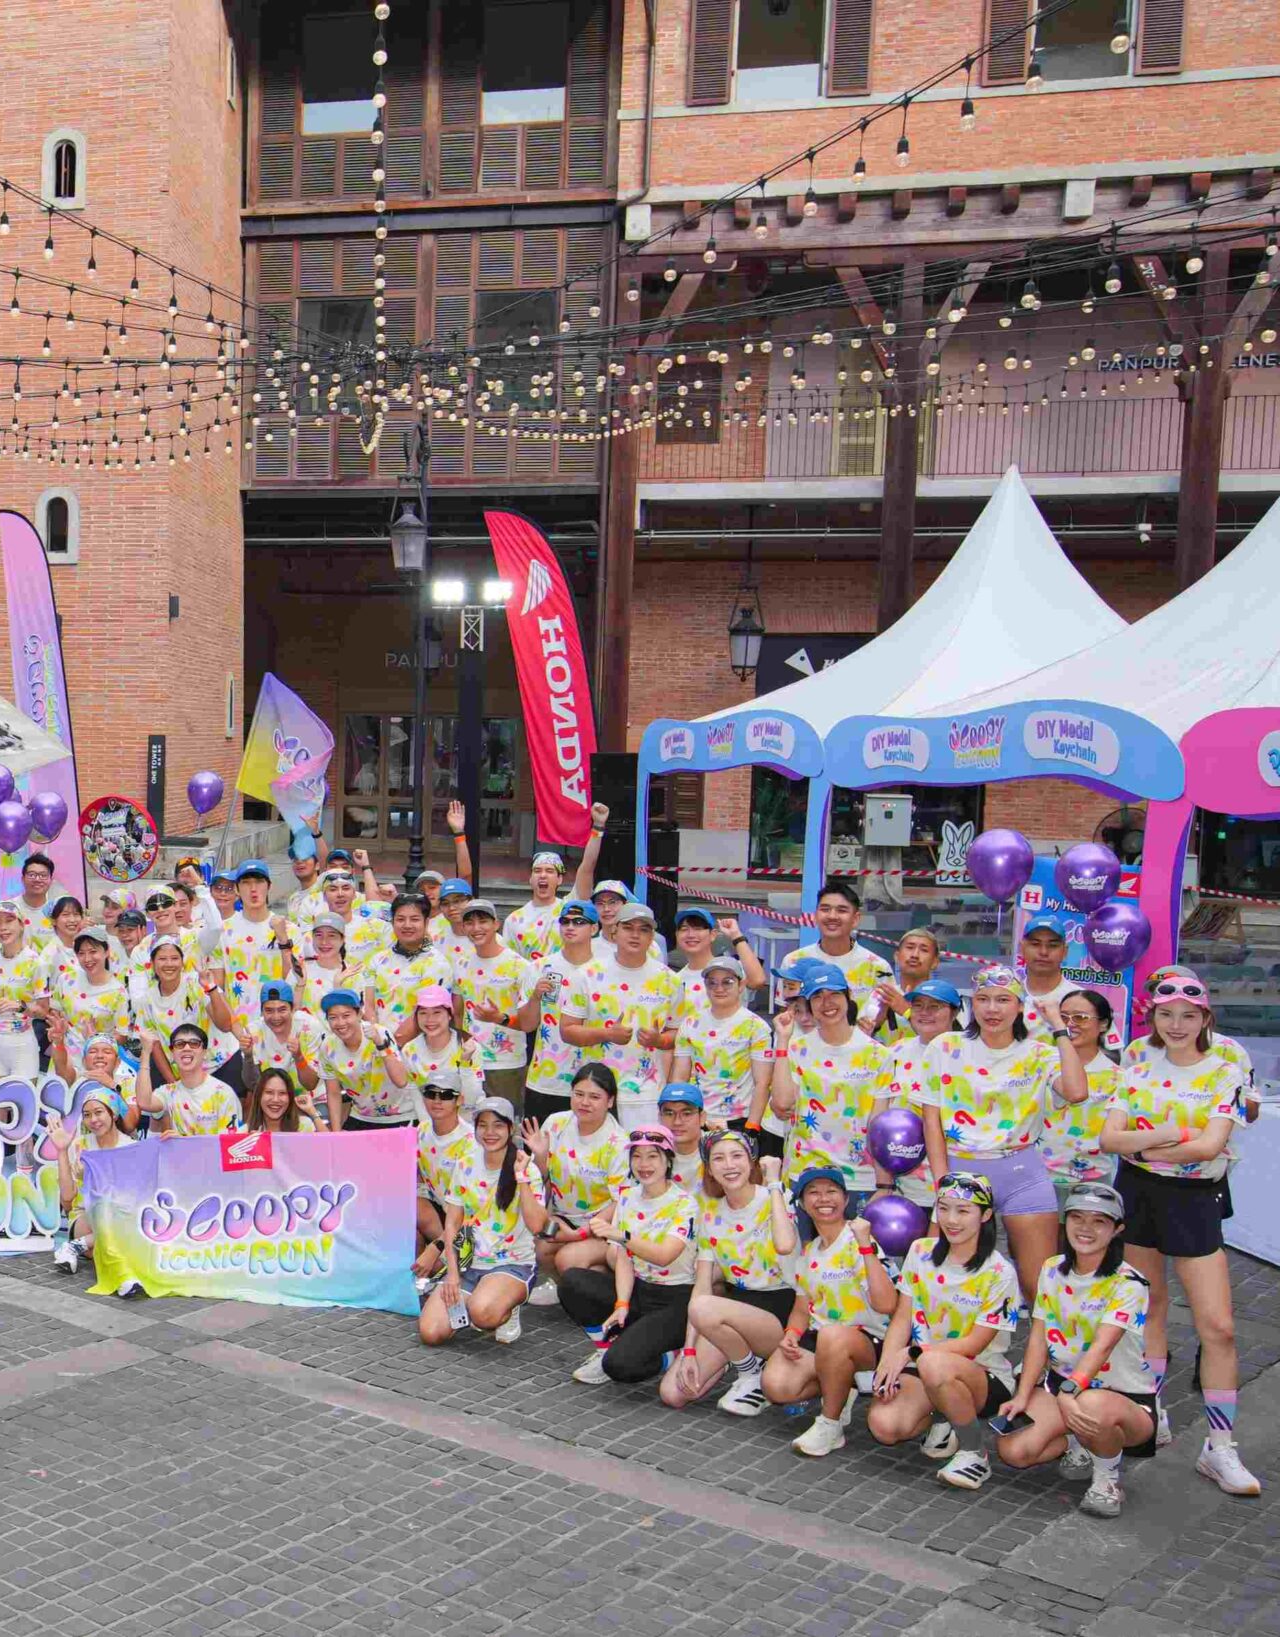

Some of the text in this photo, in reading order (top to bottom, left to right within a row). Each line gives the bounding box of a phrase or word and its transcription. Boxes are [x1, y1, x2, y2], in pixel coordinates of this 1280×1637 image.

[1036, 720, 1056, 739] DIY
[872, 733, 886, 752] DIY
[1053, 738, 1097, 764] Keychain
[1046, 898, 1061, 911] My
[229, 1155, 265, 1164] HONDA
[139, 1182, 357, 1242] SCOOPY
[248, 1235, 334, 1276] RUN
